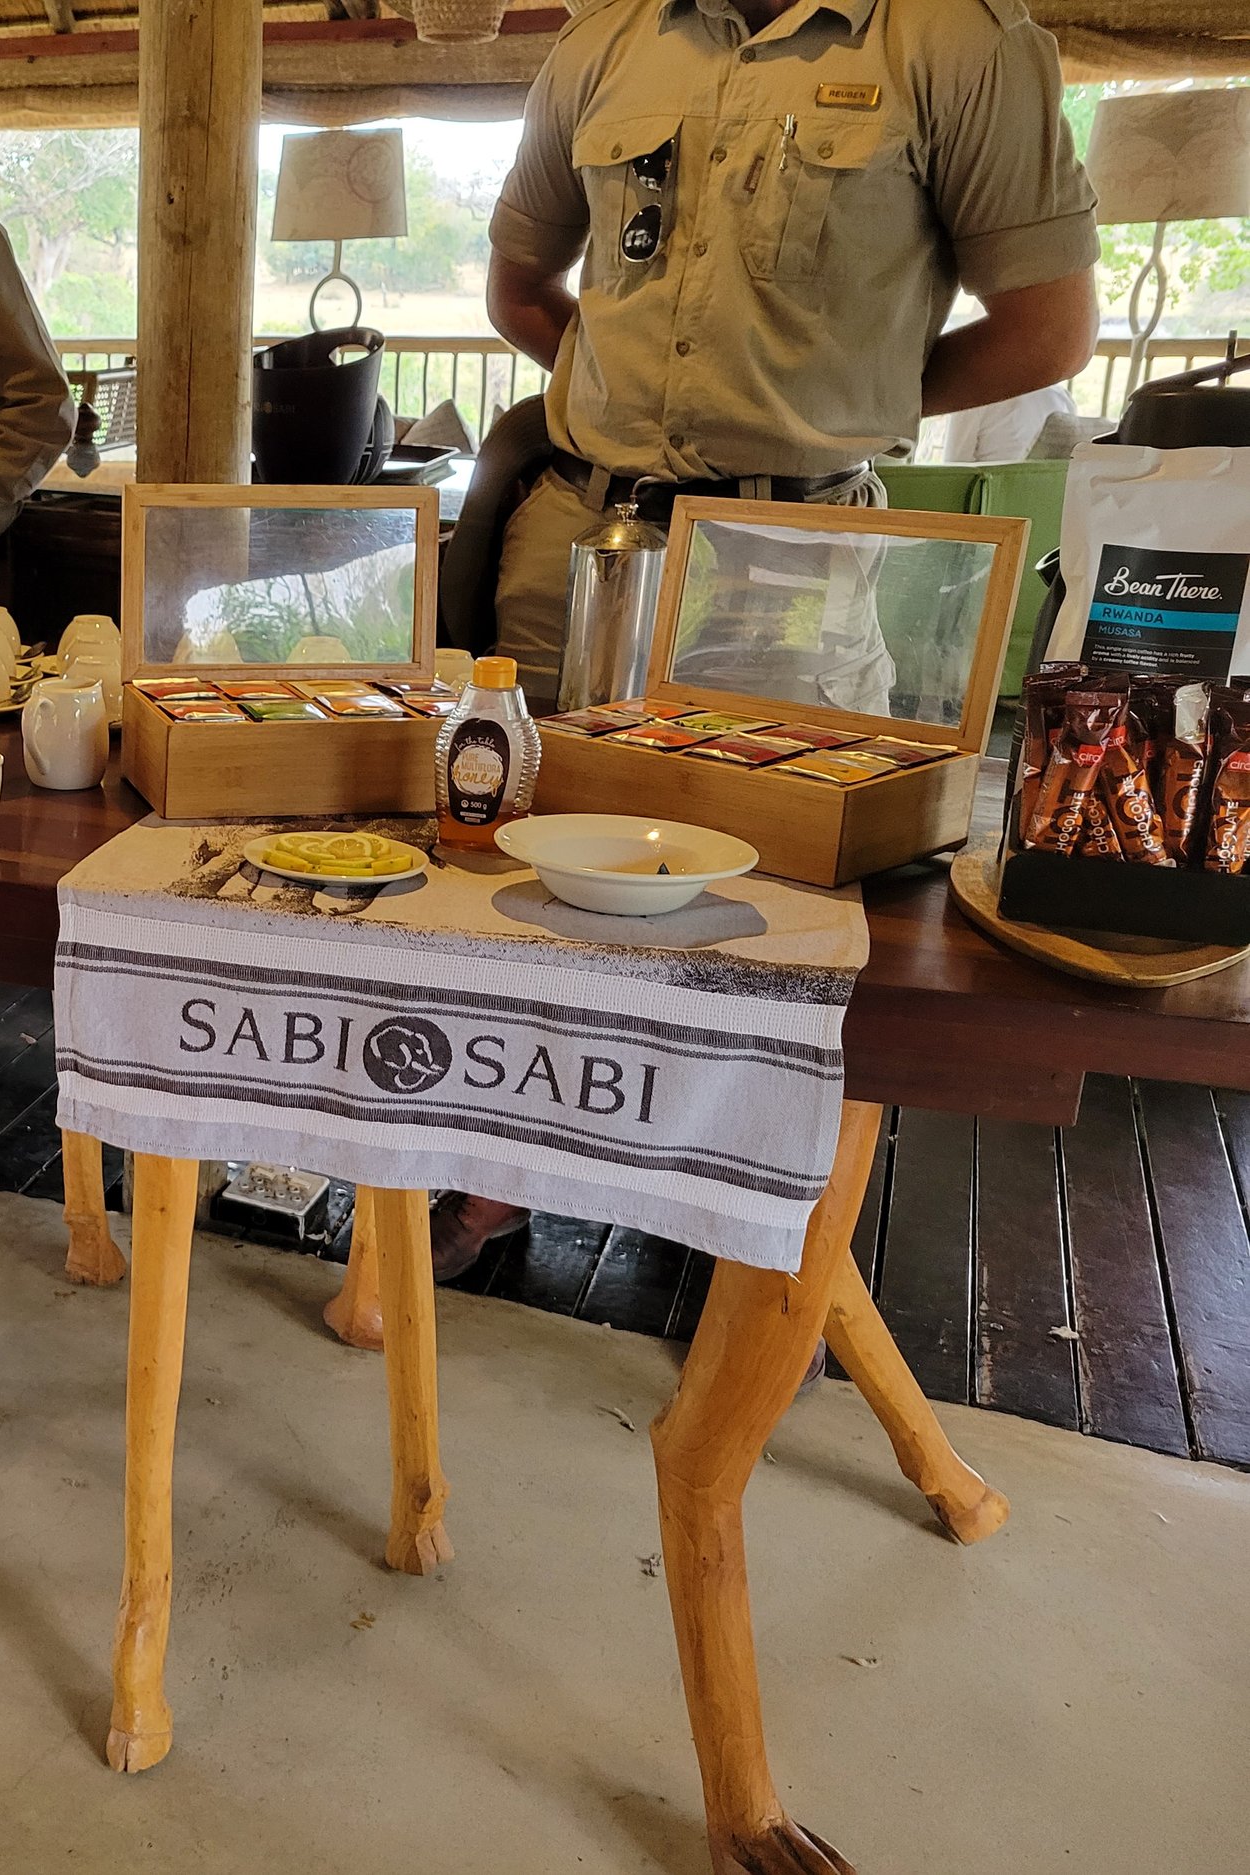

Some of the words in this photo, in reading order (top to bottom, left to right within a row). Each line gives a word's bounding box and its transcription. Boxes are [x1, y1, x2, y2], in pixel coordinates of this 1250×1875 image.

[829, 90, 866, 99] REUBEN
[1104, 566, 1164, 596] Bean
[1102, 607, 1164, 624] RWANDA
[1098, 625, 1142, 638] MUSASA
[1079, 752, 1101, 763] ciro
[453, 764, 501, 790] honey
[470, 801, 482, 809] 500
[1055, 792, 1085, 853] HOCOLATE
[1088, 792, 1109, 854] CHOCOL
[179, 998, 354, 1072] SABI
[464, 1033, 661, 1124] SABI
